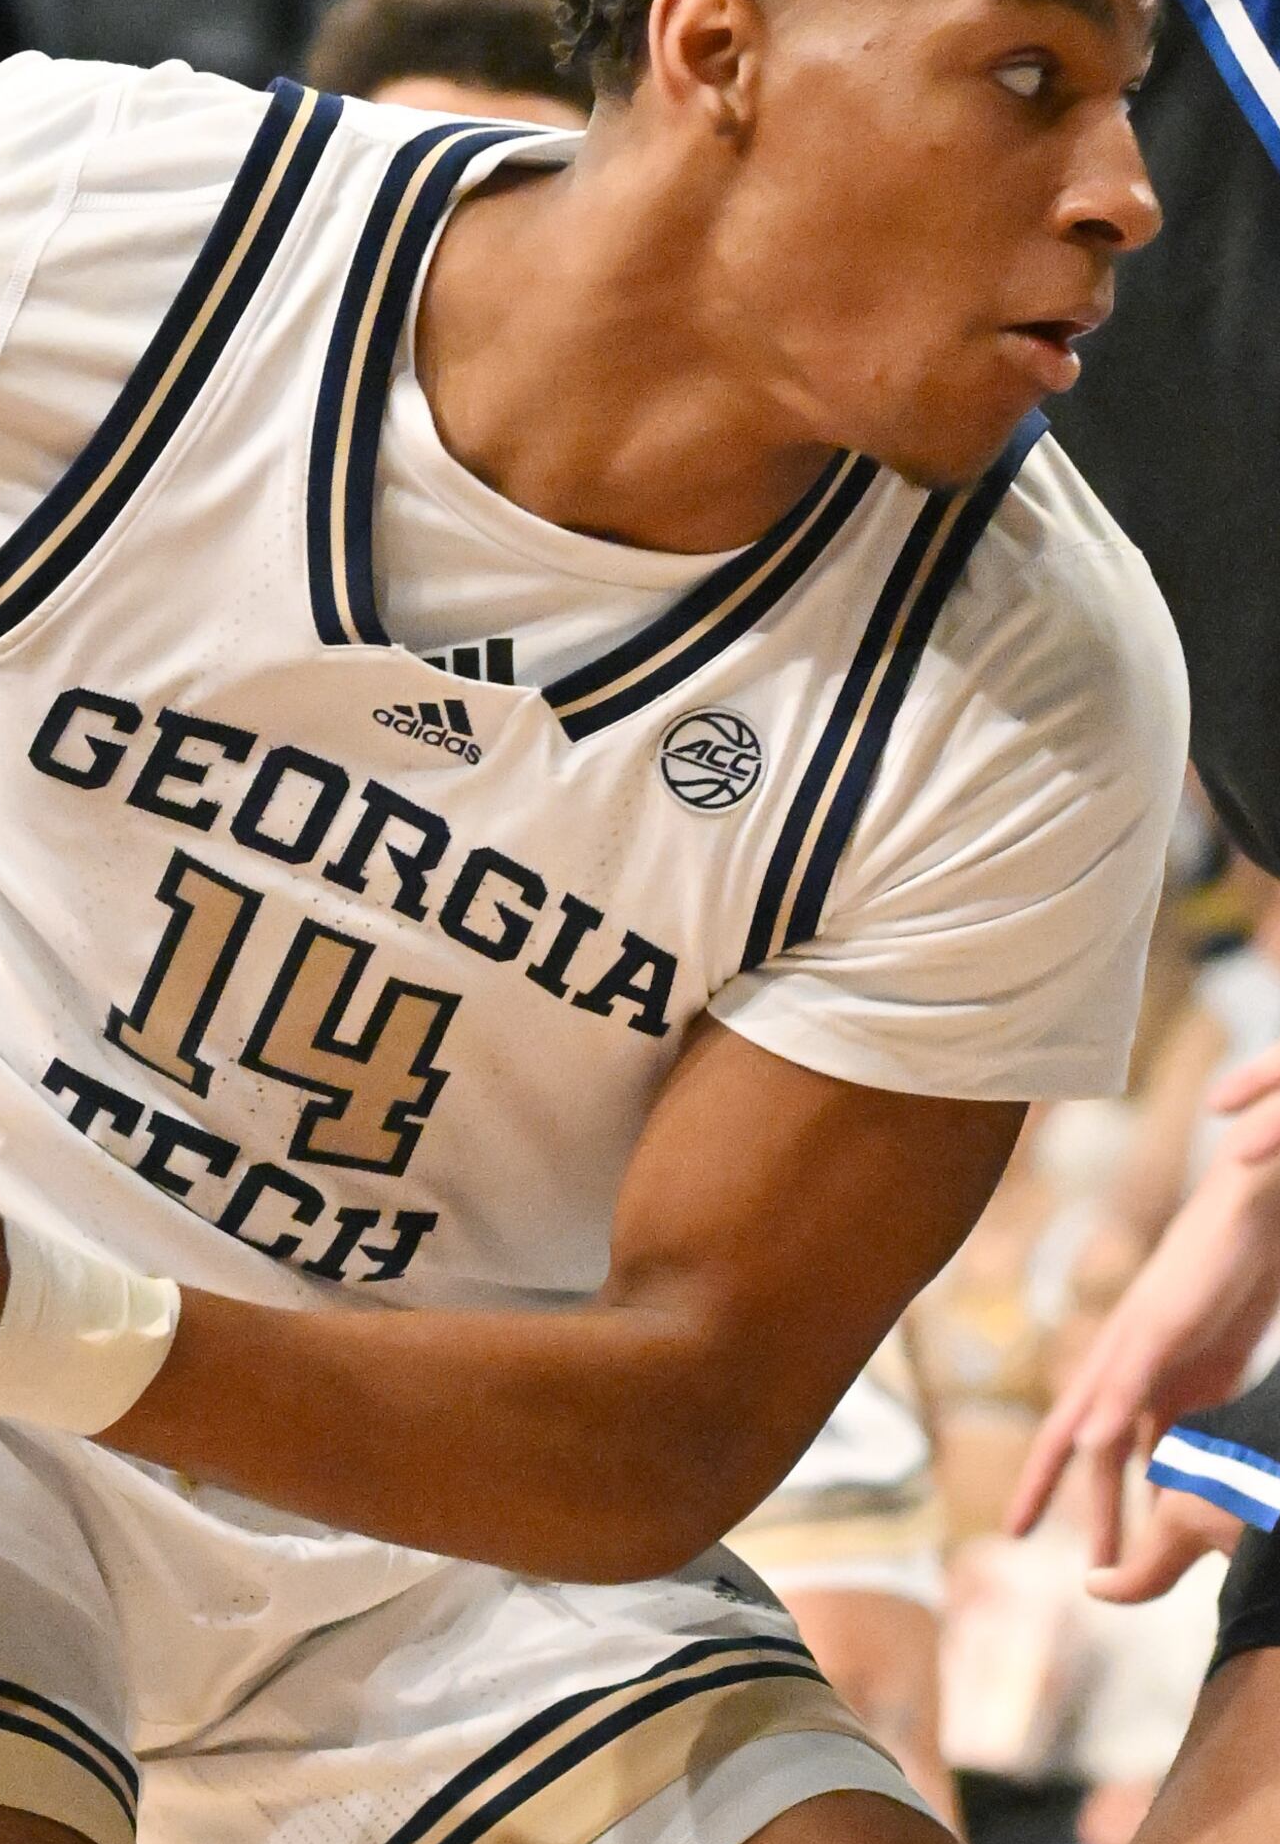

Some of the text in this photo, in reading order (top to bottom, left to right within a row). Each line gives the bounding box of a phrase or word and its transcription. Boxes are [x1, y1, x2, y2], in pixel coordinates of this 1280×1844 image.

[371, 708, 483, 766] adidas
[671, 739, 762, 777] ACC
[27, 686, 680, 1038] GEORGIA
[103, 847, 463, 1178] 14
[40, 1057, 439, 1283] TECH
